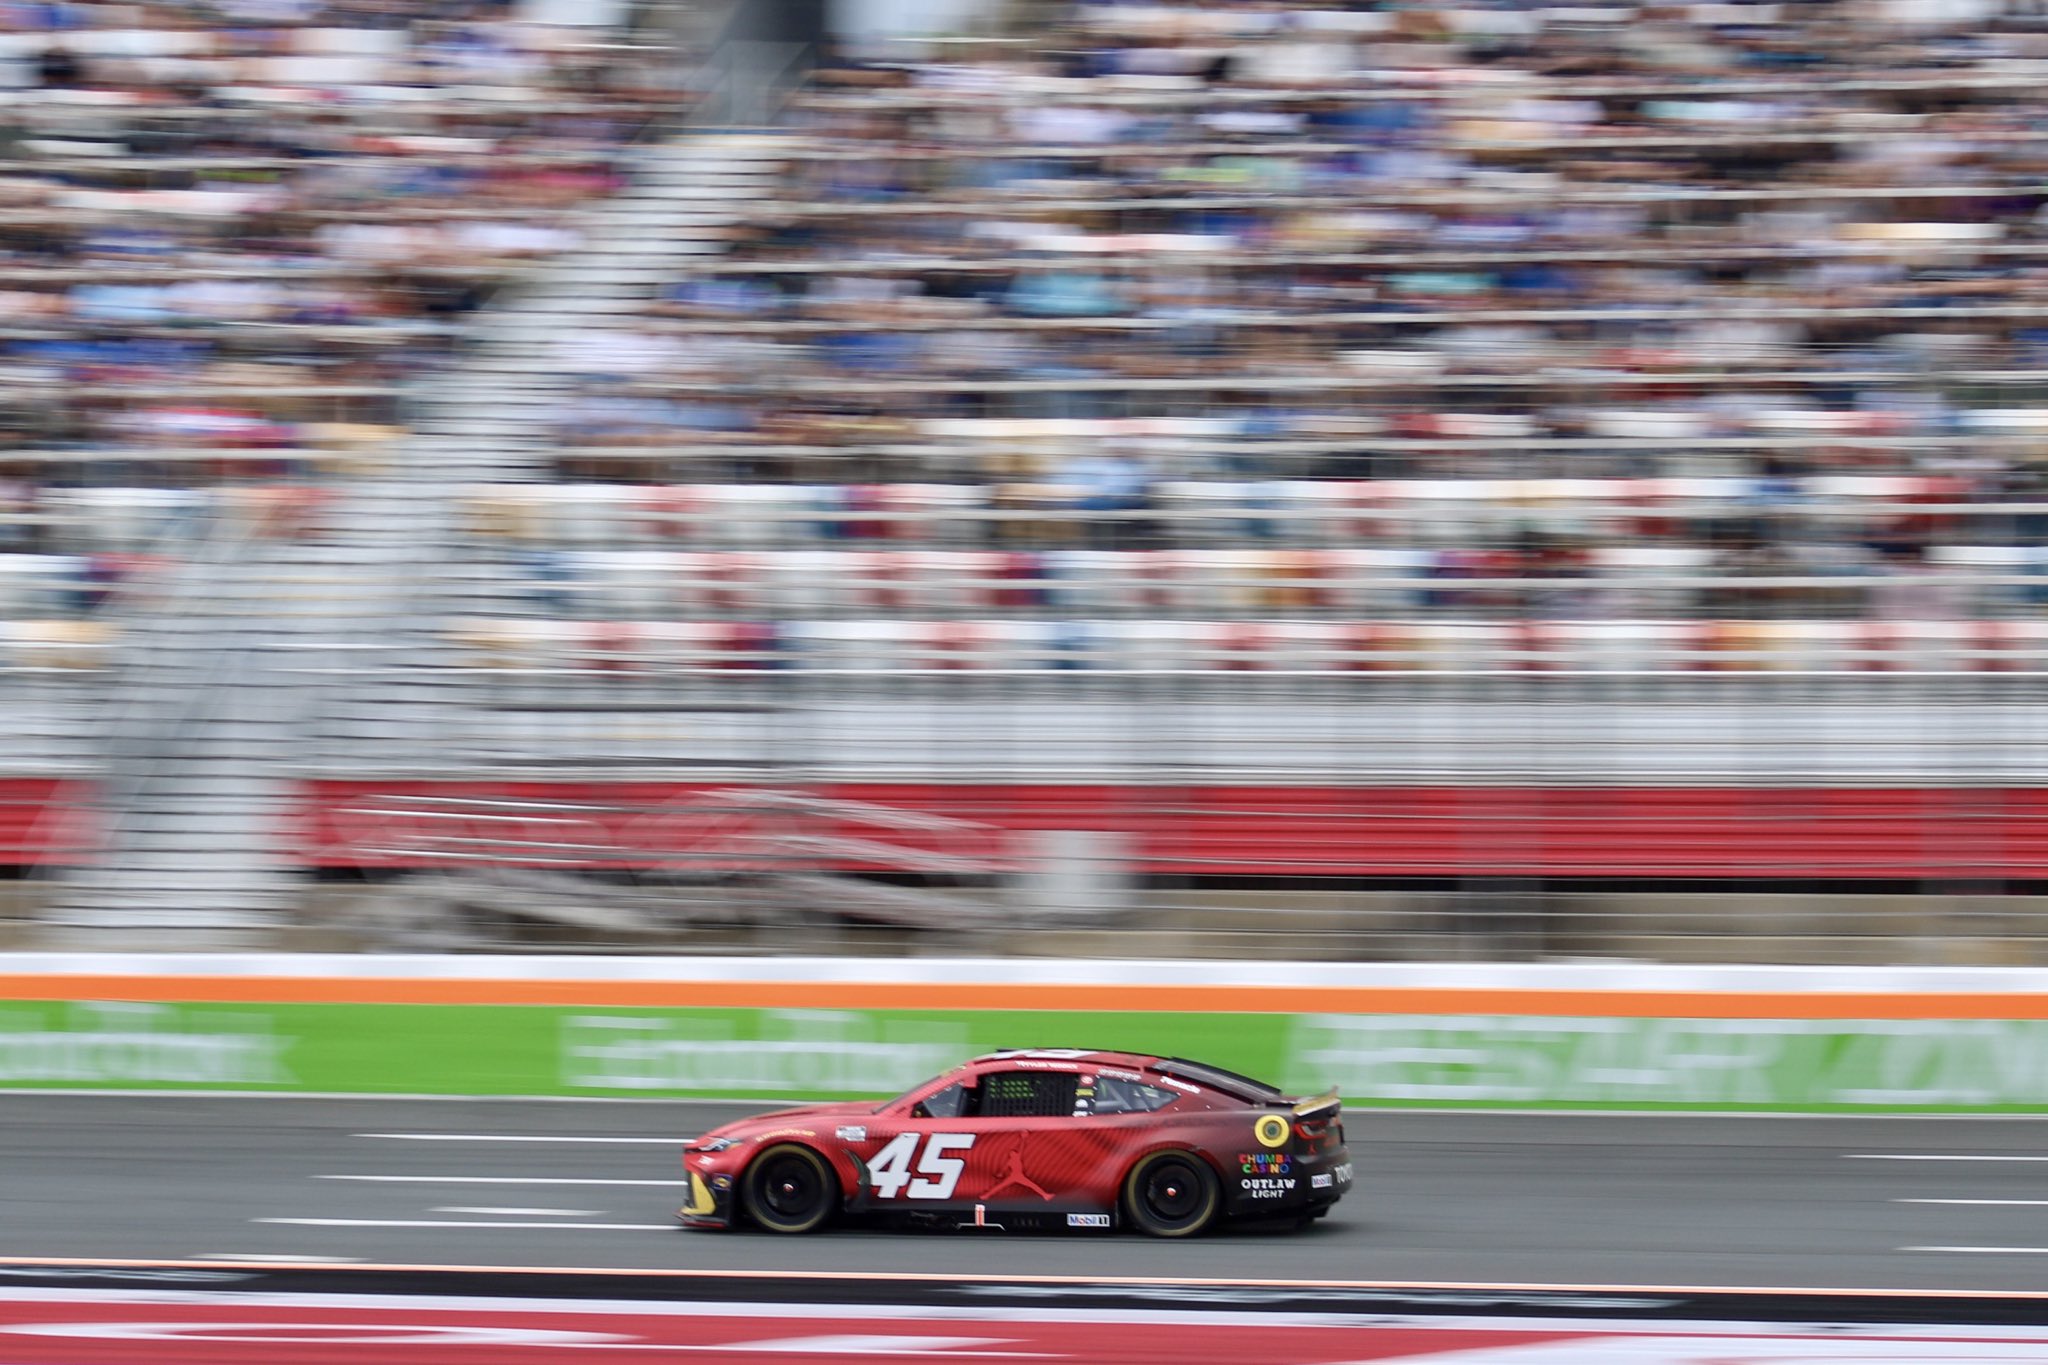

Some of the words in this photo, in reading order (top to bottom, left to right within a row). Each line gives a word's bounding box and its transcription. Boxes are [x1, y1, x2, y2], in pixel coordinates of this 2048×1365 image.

[1239, 1154, 1292, 1163] CHUMBA
[866, 1132, 976, 1199] 45
[1242, 1164, 1289, 1173] CASINO
[1241, 1179, 1296, 1189] OUTLAW
[1252, 1190, 1285, 1199] LIGHT
[1069, 1216, 1097, 1225] Mobil
